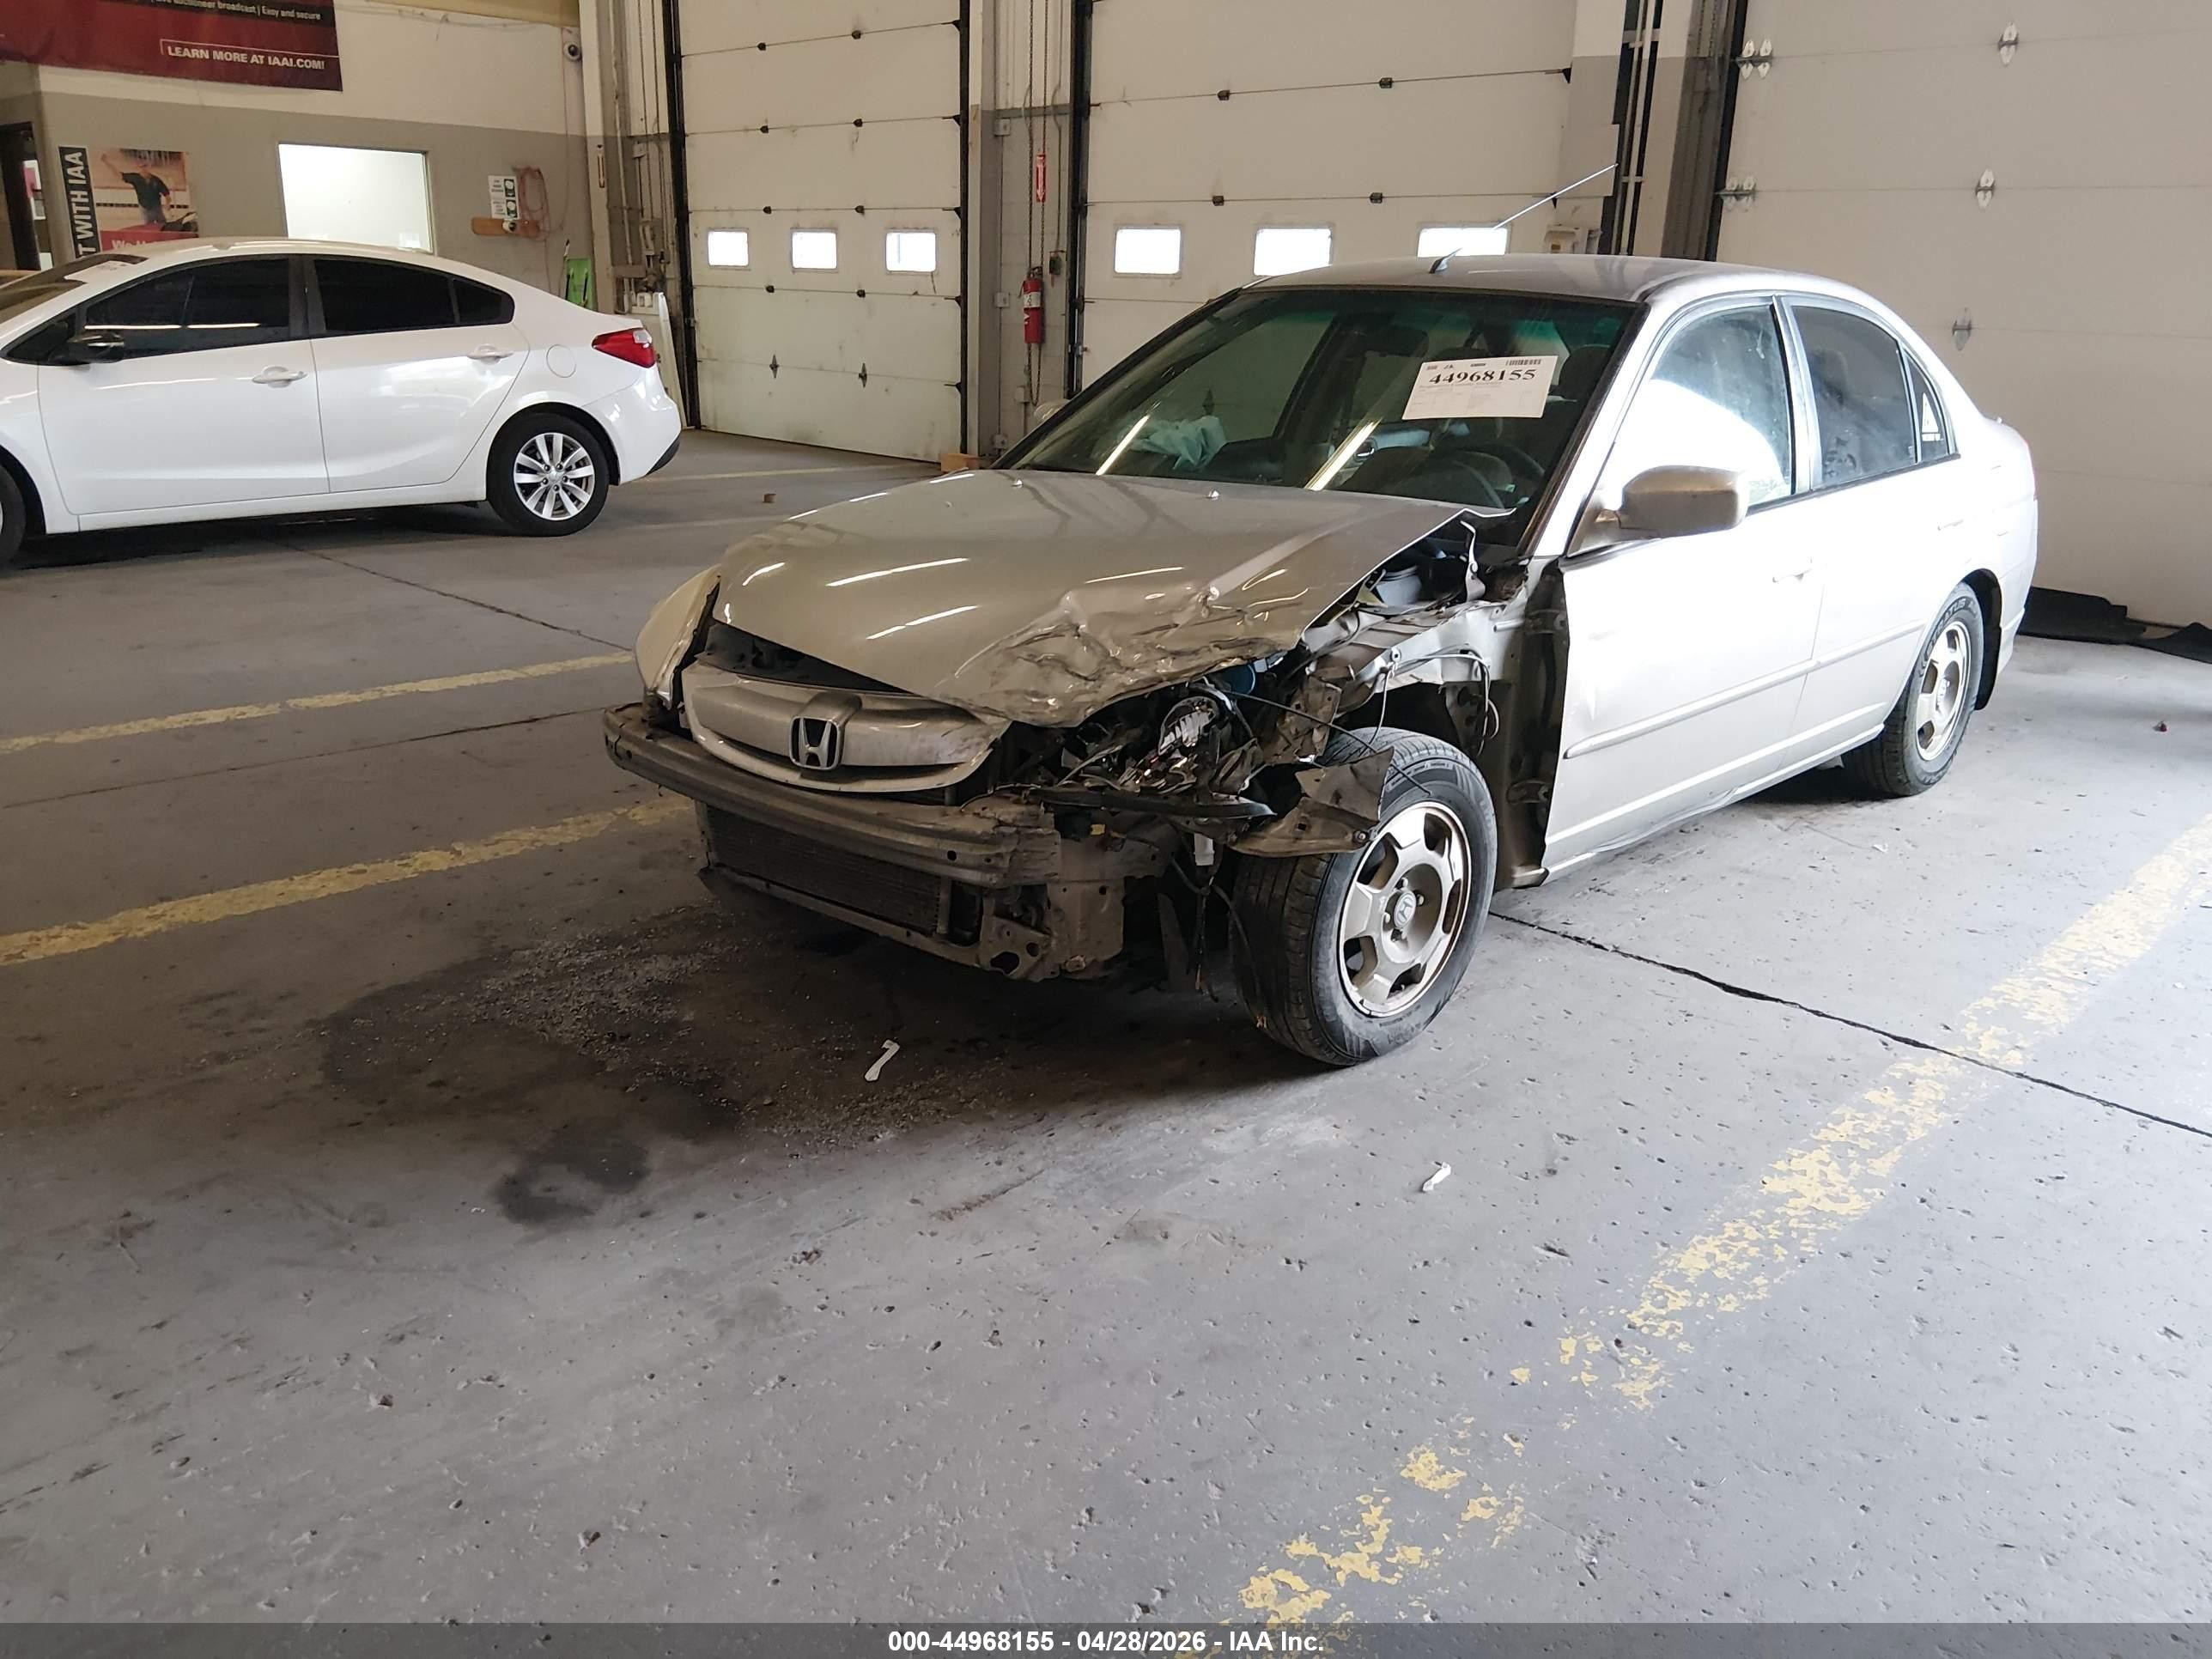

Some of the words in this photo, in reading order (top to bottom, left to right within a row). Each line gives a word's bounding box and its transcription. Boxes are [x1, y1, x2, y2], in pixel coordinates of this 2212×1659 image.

[217, 0, 256, 14] broadcast
[262, 6, 279, 18] Easy
[296, 10, 321, 21] secure
[167, 46, 209, 59] LEARN
[212, 51, 248, 63] MORE
[250, 56, 264, 64] AT
[268, 57, 325, 70] IAAI.COM!
[65, 151, 87, 184] IAA
[70, 191, 94, 240] WITH
[1429, 369, 1537, 385] 44968155
